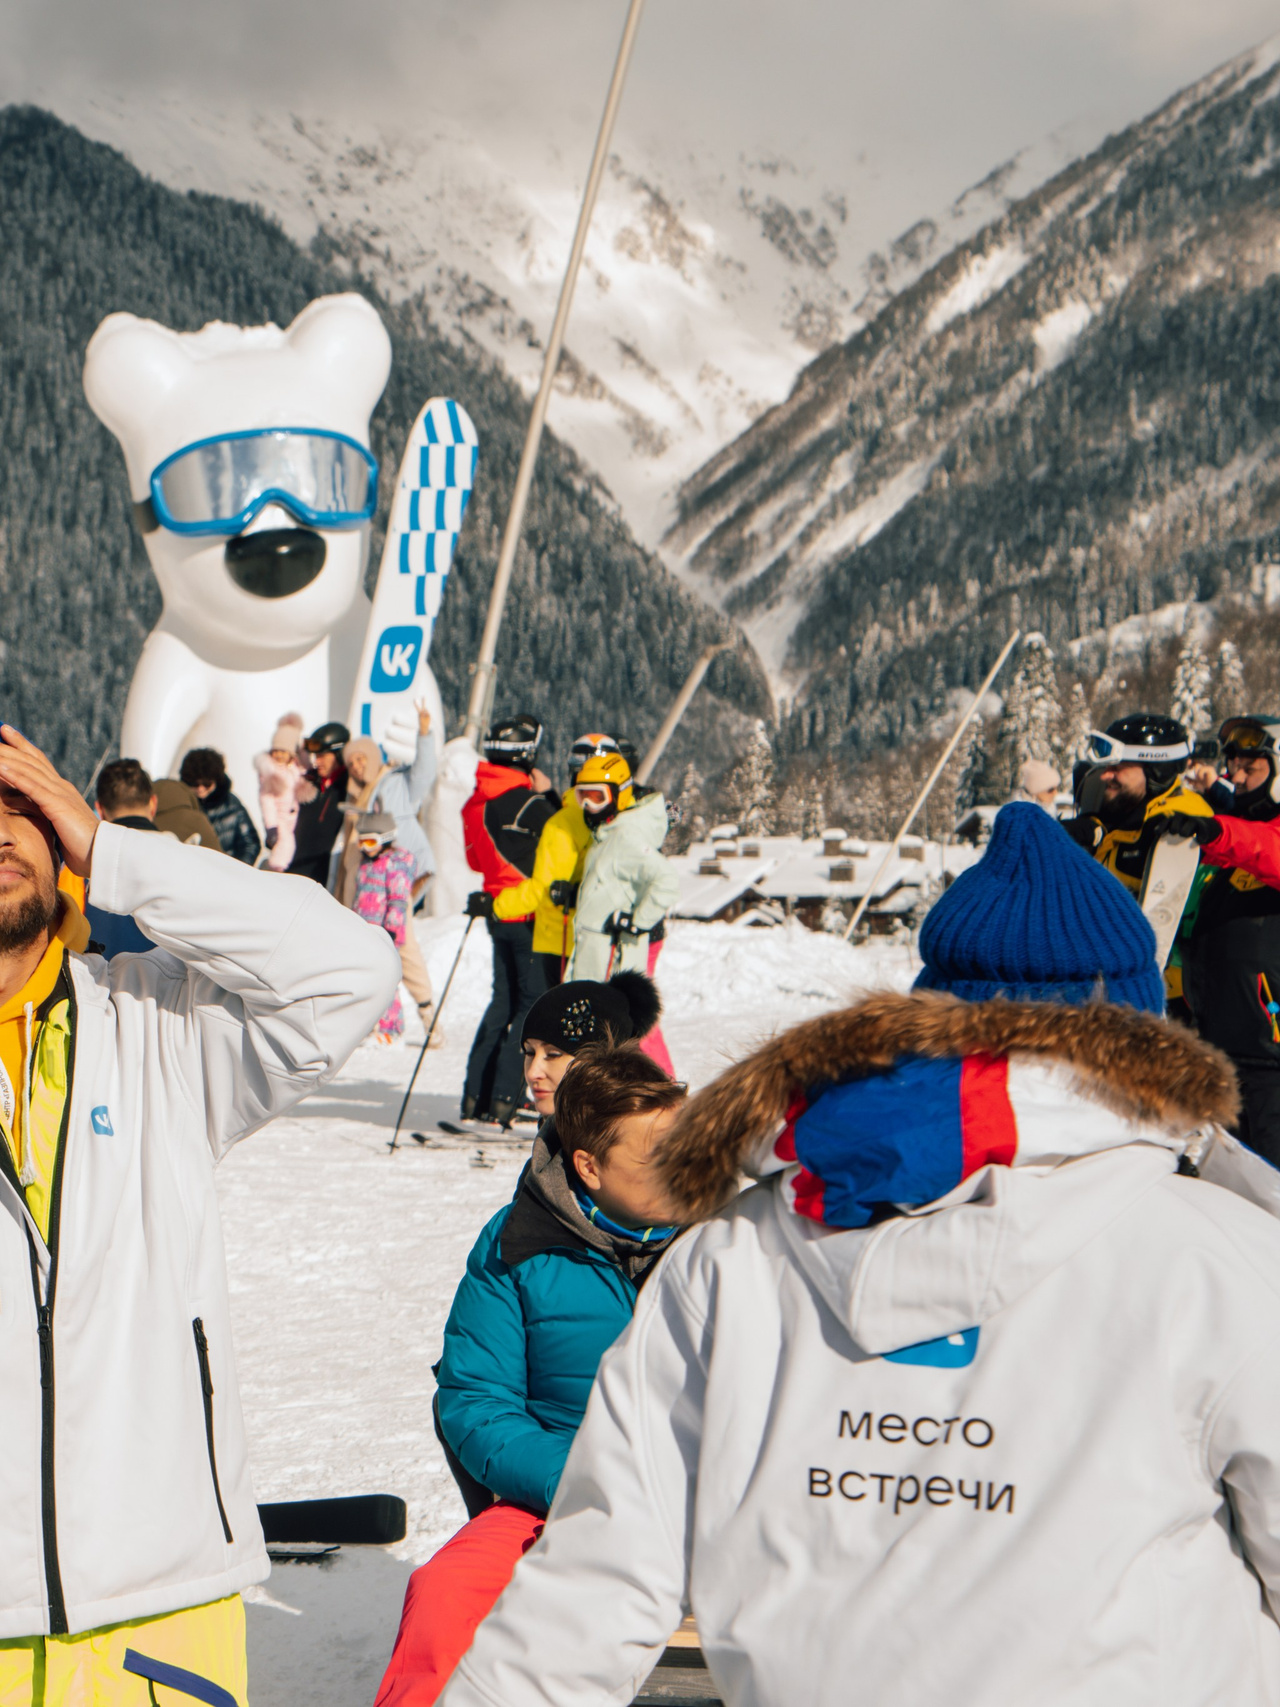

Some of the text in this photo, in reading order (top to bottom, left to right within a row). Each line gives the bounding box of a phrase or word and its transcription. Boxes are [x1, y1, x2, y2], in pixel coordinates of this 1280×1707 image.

[381, 643, 415, 677] VK
[837, 1409, 996, 1449] место
[807, 1466, 1017, 1516] встречи
